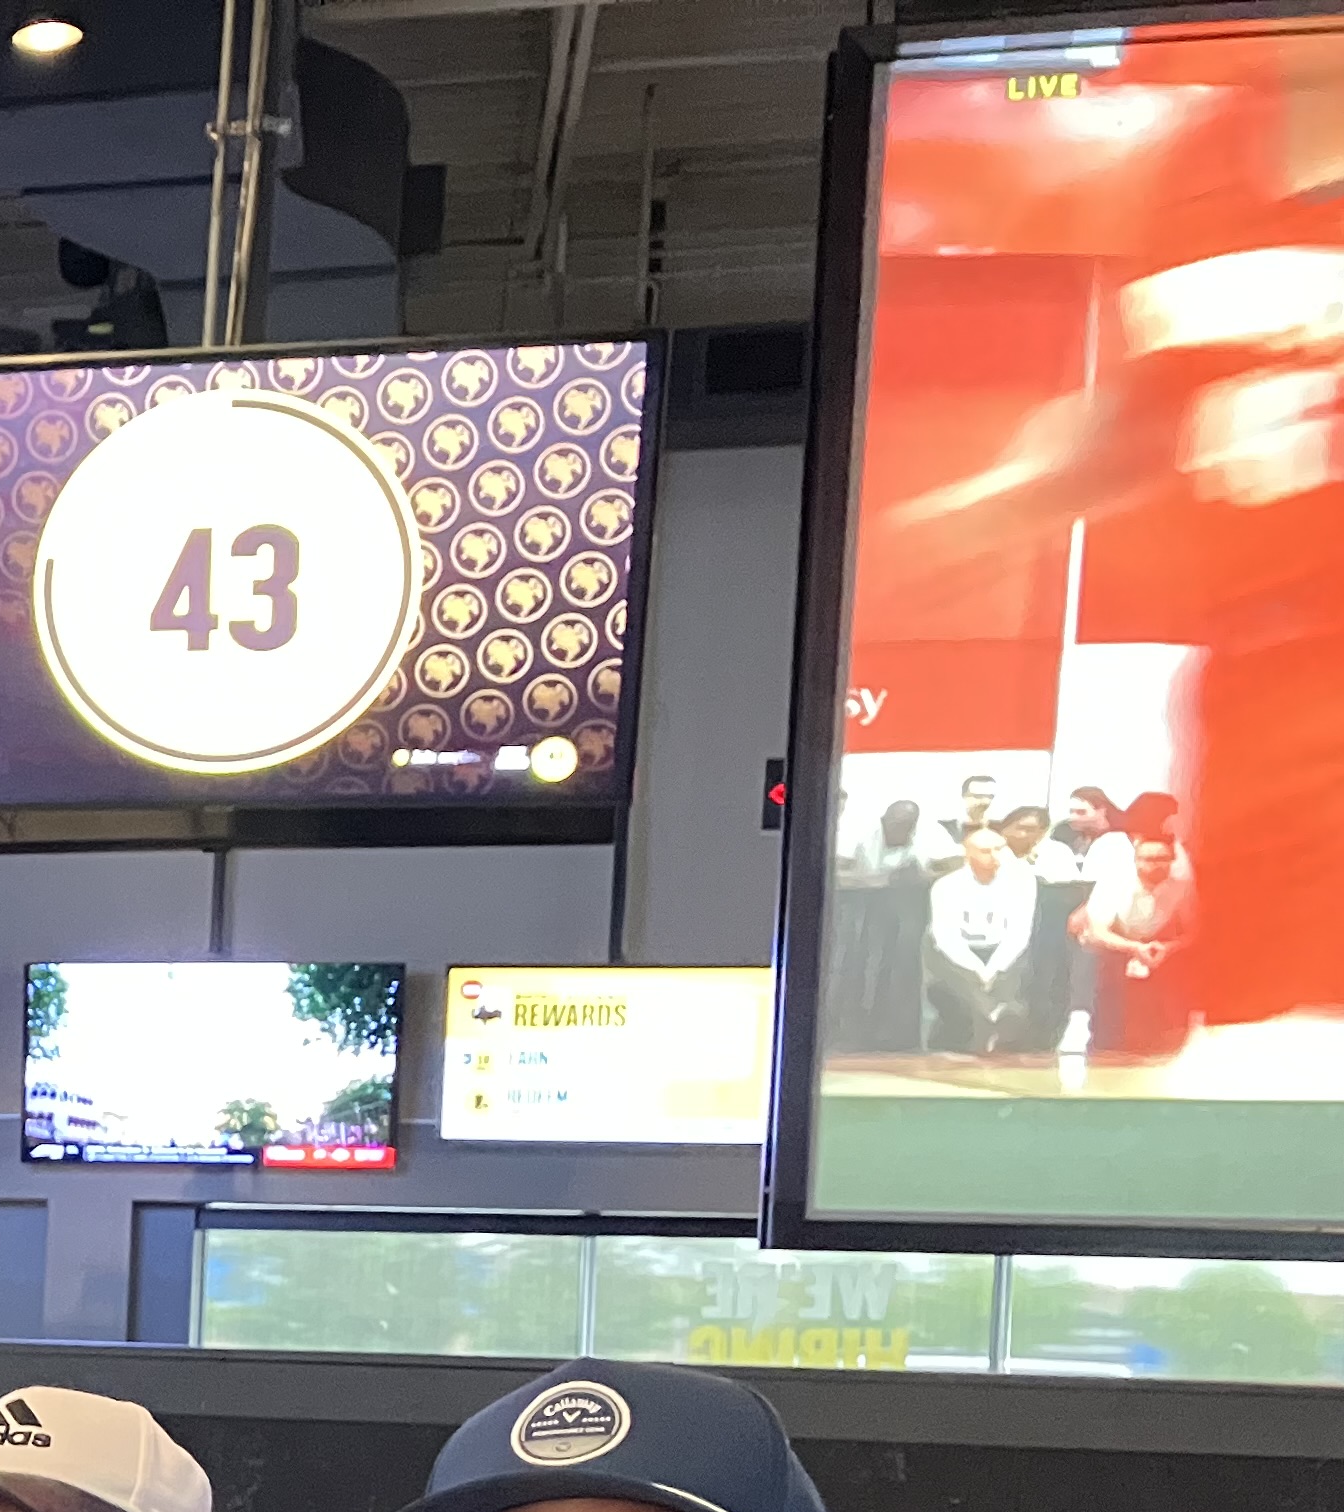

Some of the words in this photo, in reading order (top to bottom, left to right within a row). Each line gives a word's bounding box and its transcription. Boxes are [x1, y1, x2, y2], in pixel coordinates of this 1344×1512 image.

[1008, 73, 1079, 101] LIVE
[150, 524, 300, 652] 43
[514, 1003, 628, 1027] REWARDS
